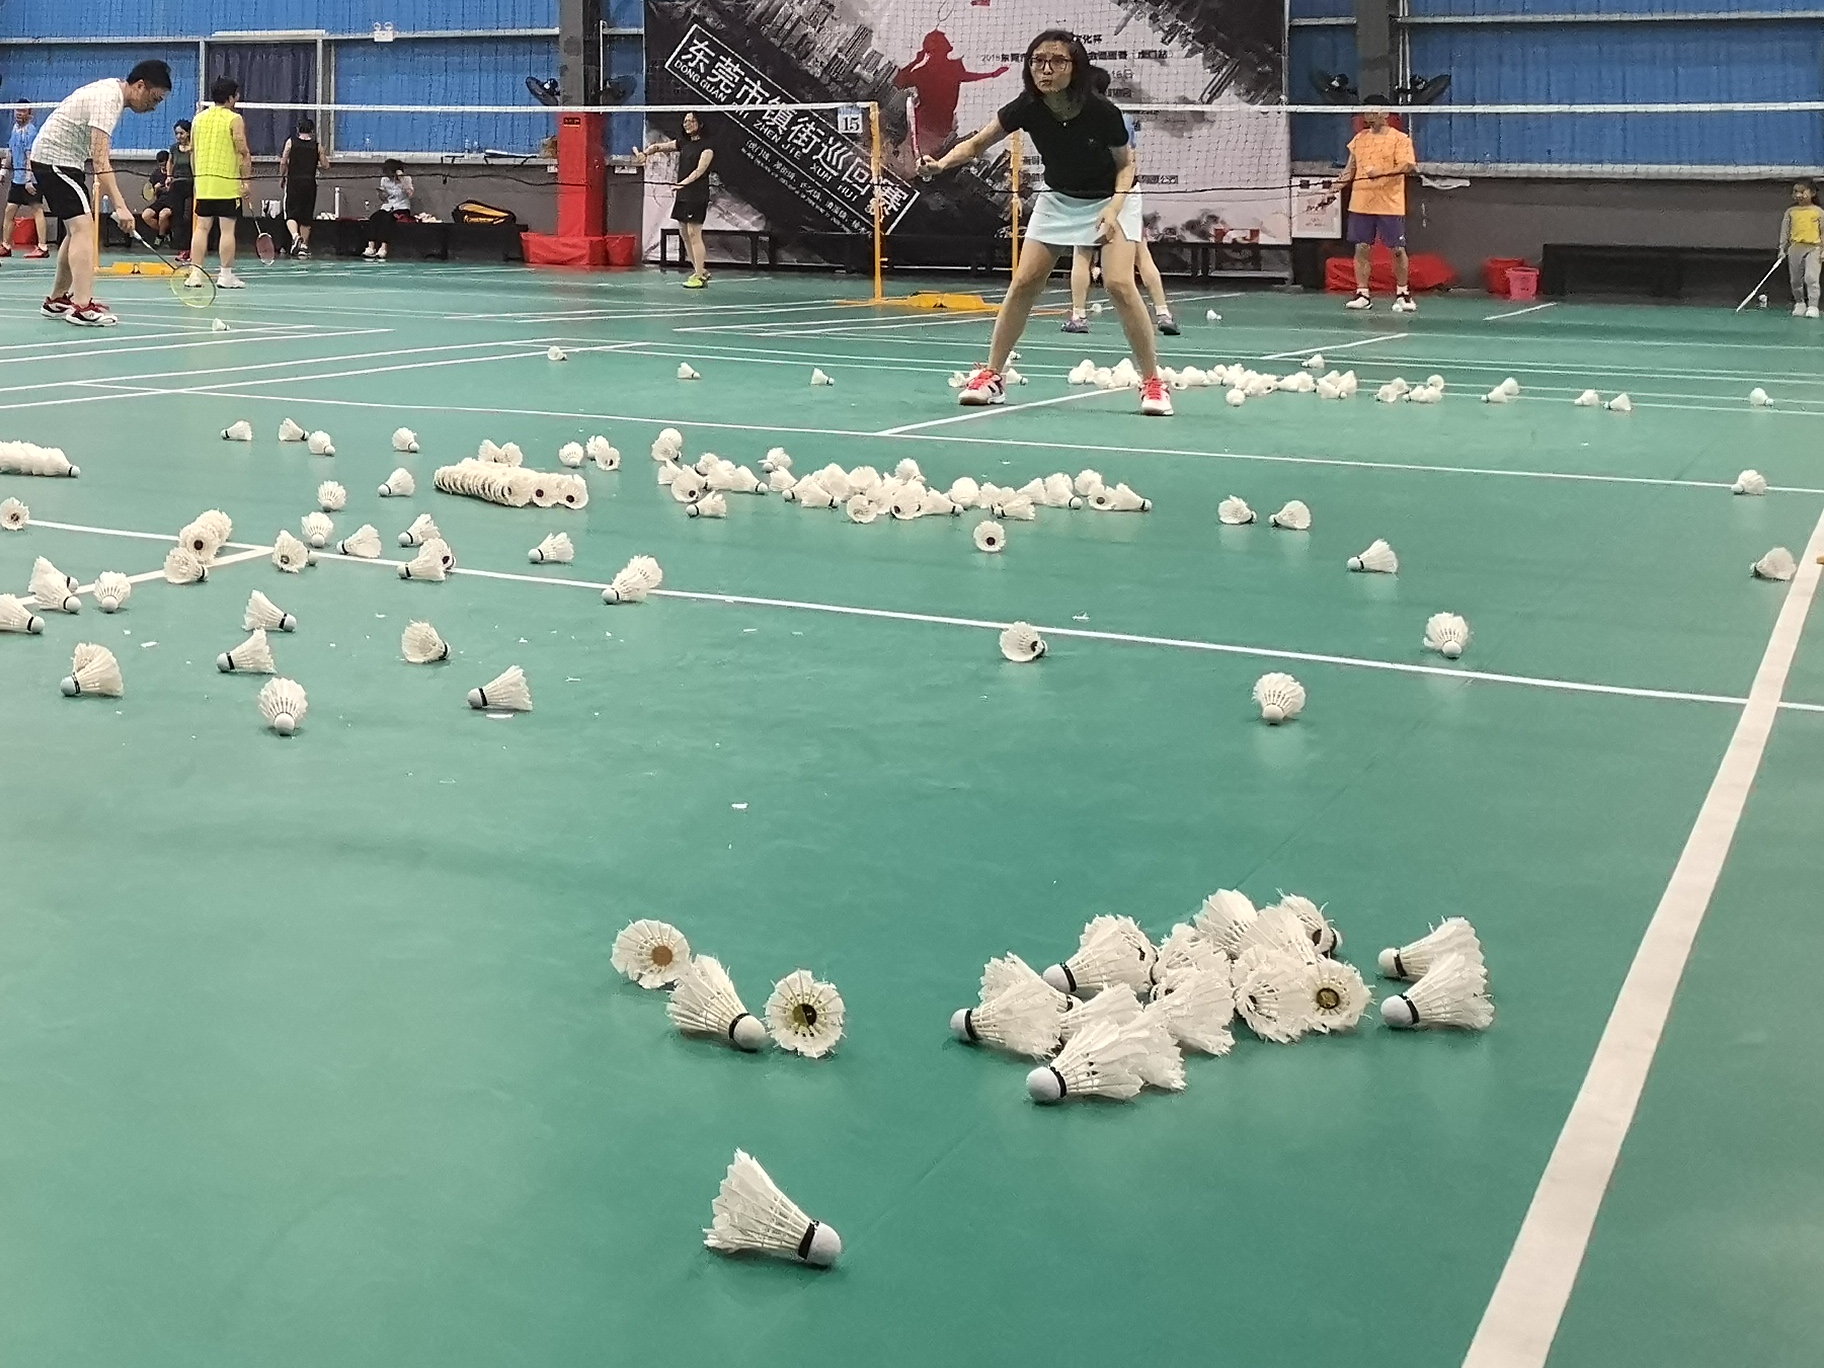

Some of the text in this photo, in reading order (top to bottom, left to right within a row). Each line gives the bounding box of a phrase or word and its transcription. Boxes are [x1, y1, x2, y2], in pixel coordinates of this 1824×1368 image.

[674, 60, 700, 84] DONG
[699, 79, 726, 103] GUAN
[752, 120, 782, 144] ZHEN
[781, 143, 803, 161] JIE
[809, 162, 834, 183] XUN
[836, 184, 860, 203] HUI
[842, 116, 860, 132] 15
